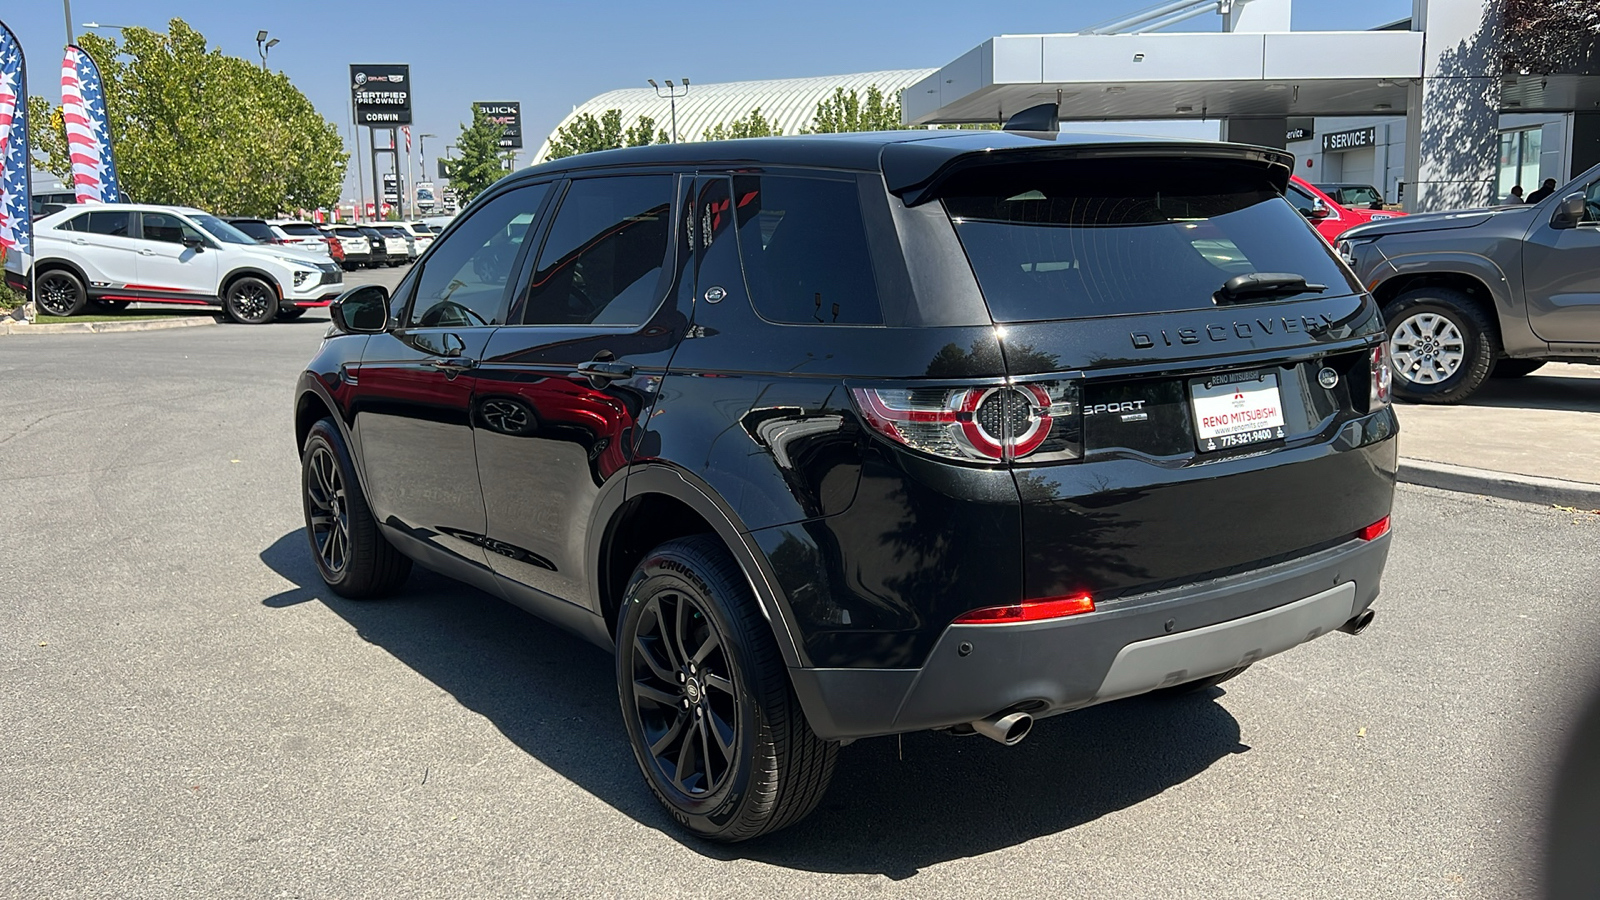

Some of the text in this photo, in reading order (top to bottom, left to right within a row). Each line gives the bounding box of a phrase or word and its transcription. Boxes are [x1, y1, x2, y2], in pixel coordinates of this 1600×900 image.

[356, 91, 407, 99] CERTIFIED
[366, 113, 399, 121] CORWIN
[479, 106, 517, 114] BUICK
[1331, 131, 1366, 149] SERVICE
[1129, 312, 1334, 350] DISCOVERY
[1211, 370, 1259, 385] RENO MITSUBISHI
[1083, 400, 1146, 415] SPORT
[1202, 407, 1278, 428] RENO MITSUBISHI
[1221, 429, 1272, 447] 775-321-9400
[659, 560, 713, 597] CRUGEN
